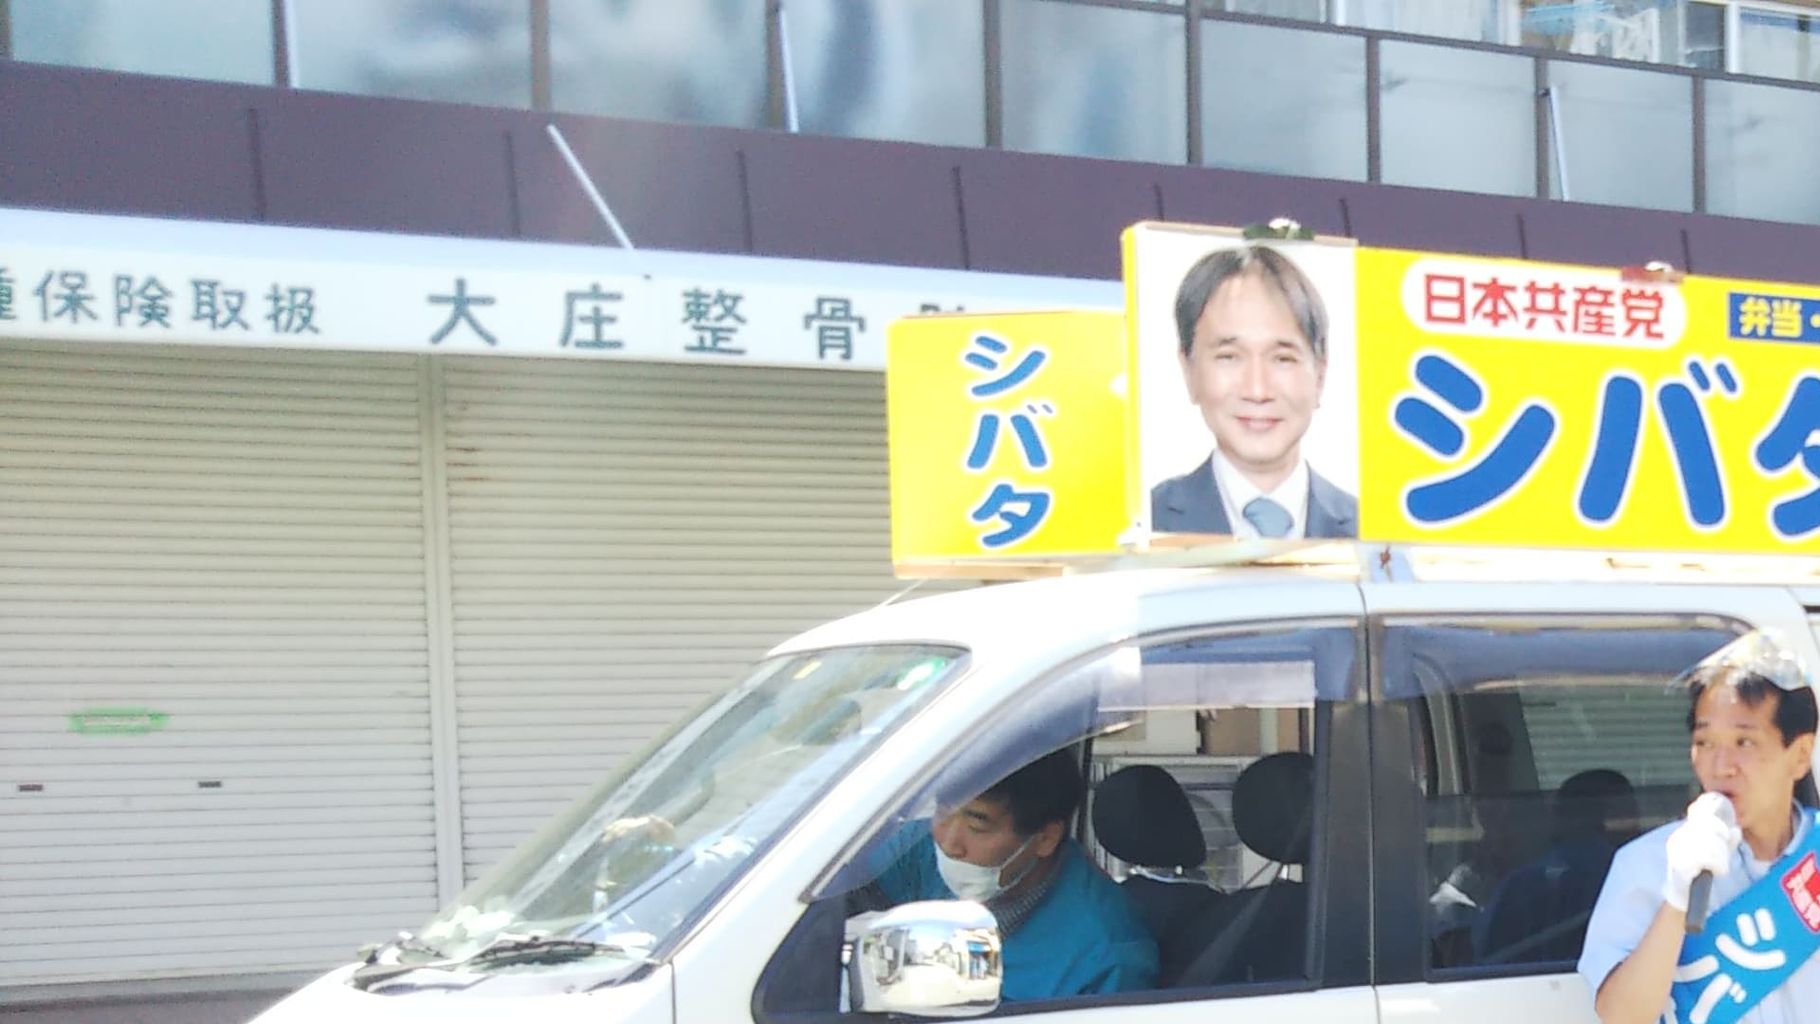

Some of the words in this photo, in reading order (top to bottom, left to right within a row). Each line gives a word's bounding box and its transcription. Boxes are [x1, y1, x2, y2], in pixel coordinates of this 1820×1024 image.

[427, 278, 966, 360] 大庄整骨
[1424, 273, 1665, 338] 日本共産党
[964, 336, 1053, 548] シバタ
